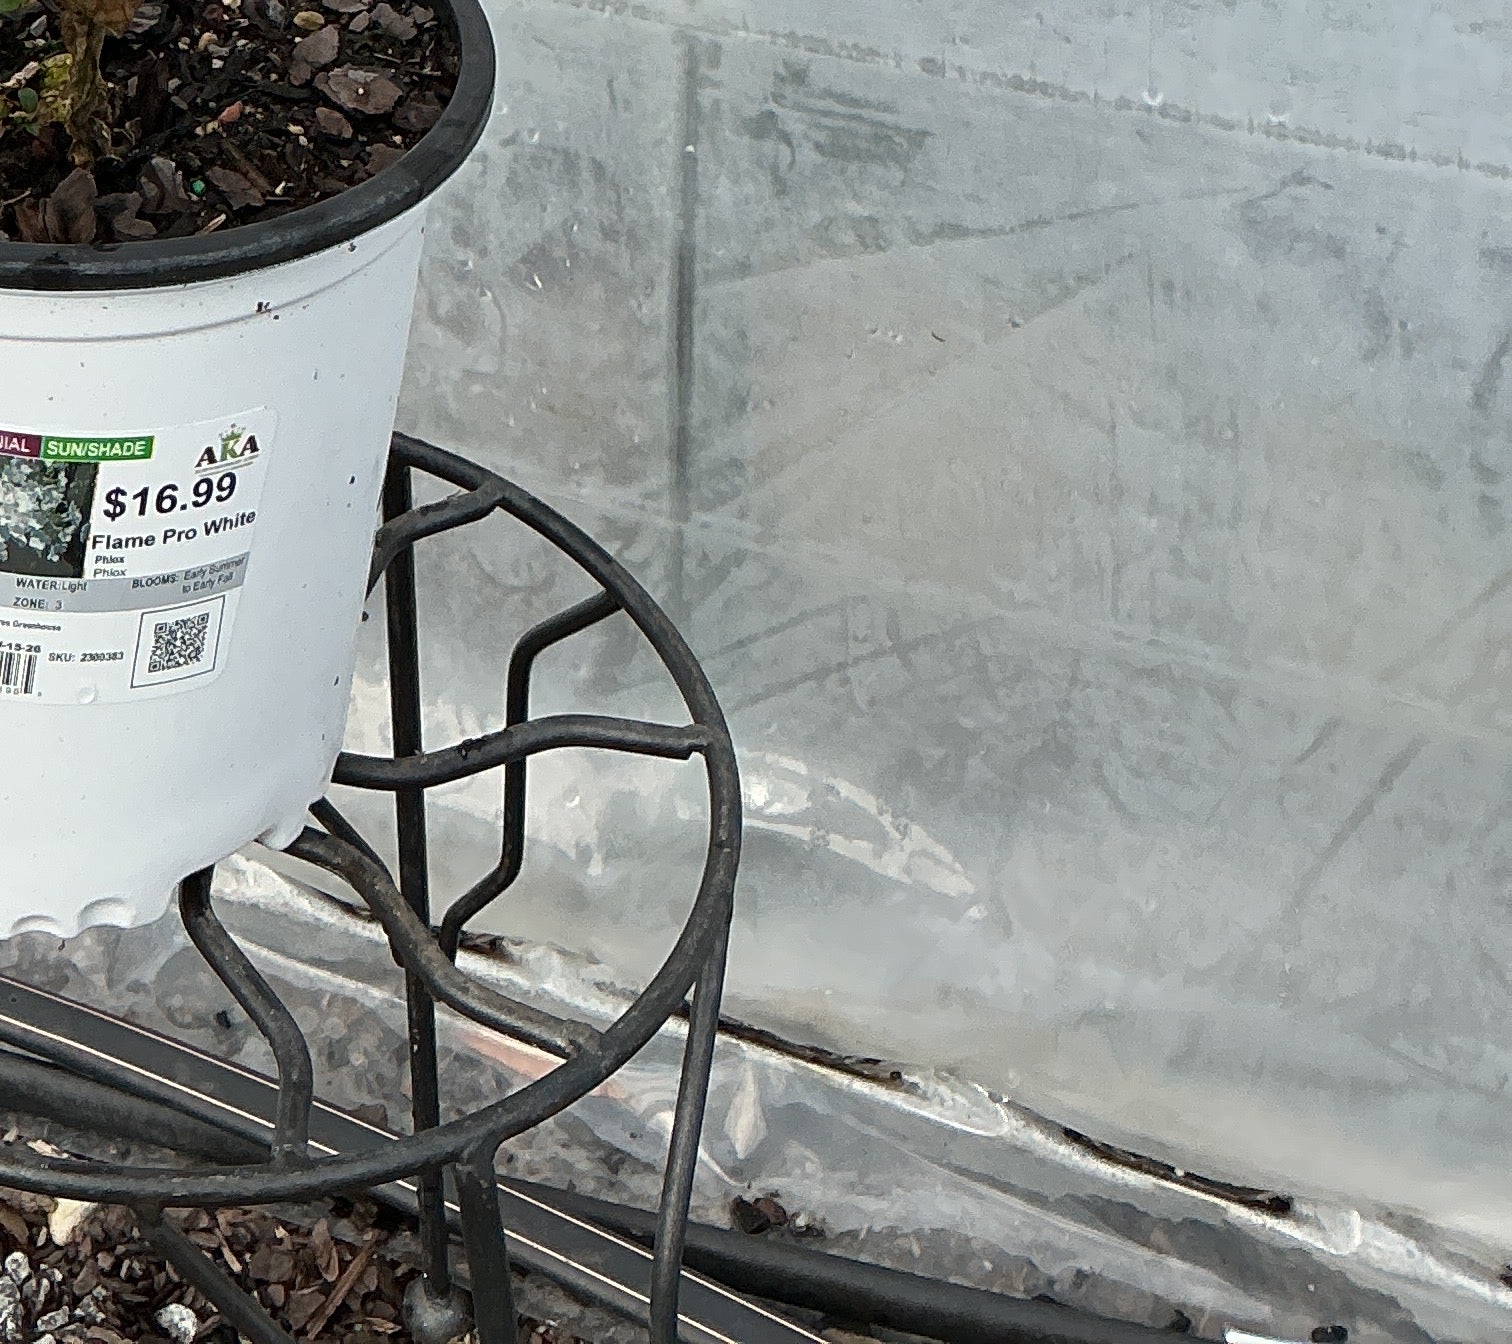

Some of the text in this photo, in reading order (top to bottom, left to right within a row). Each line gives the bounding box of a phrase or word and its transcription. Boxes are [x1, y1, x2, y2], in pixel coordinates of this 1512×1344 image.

[46, 440, 147, 457] SUN/SHADE
[194, 434, 260, 468] AKA
[102, 471, 237, 522] $16.99
[91, 511, 256, 550] Flame Pro White
[93, 567, 128, 578] Phlox
